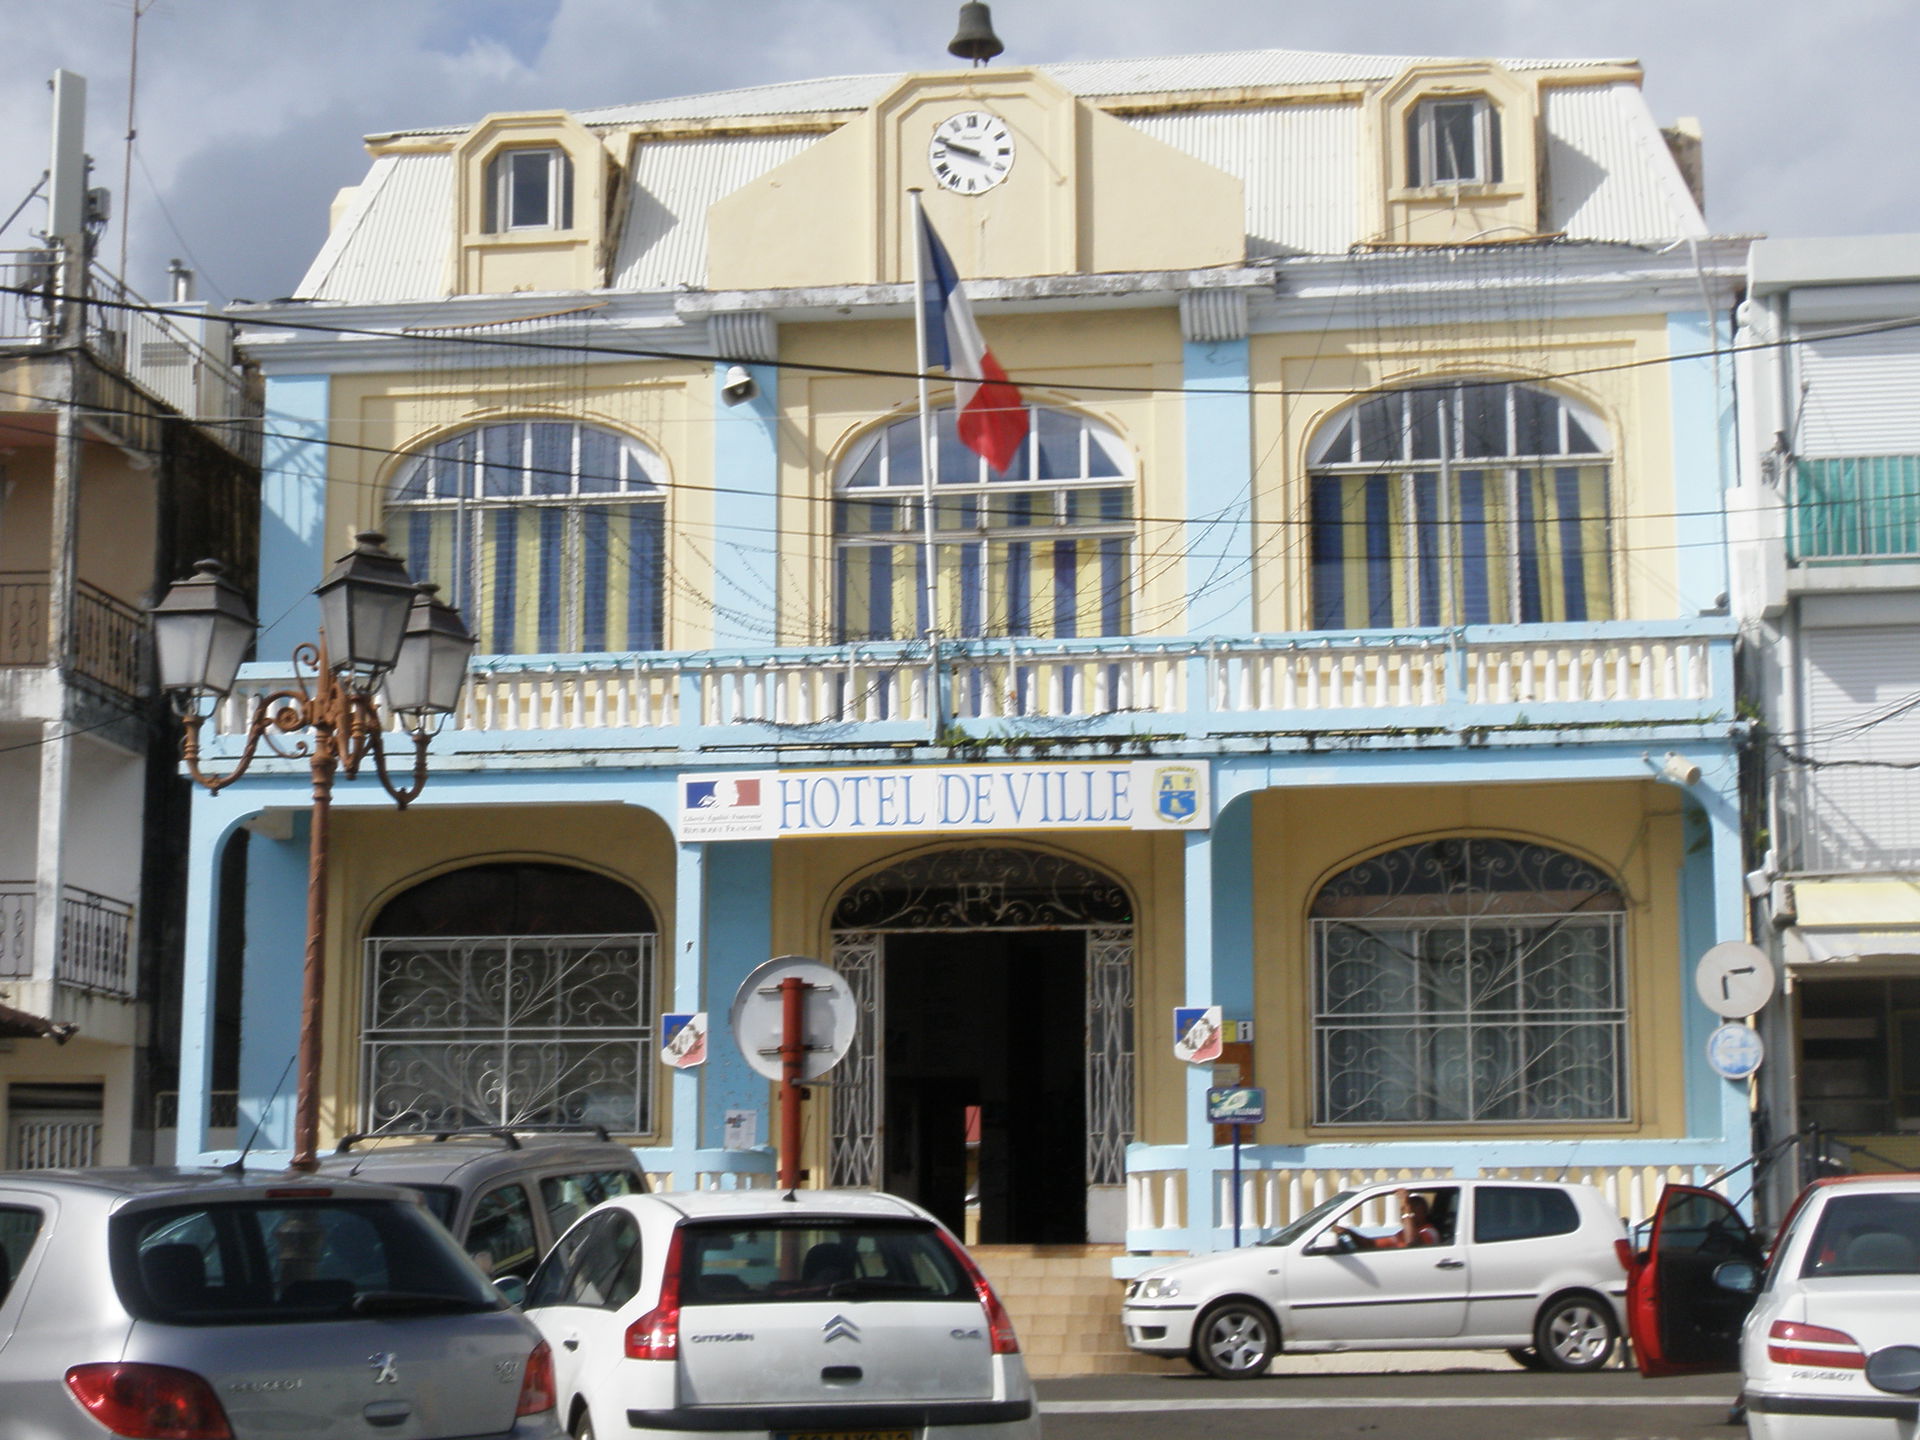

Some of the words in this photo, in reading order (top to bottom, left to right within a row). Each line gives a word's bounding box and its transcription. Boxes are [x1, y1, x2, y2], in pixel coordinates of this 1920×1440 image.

[777, 775, 926, 830] HOTEL
[939, 773, 996, 825] DE
[1000, 770, 1134, 824] VILLE
